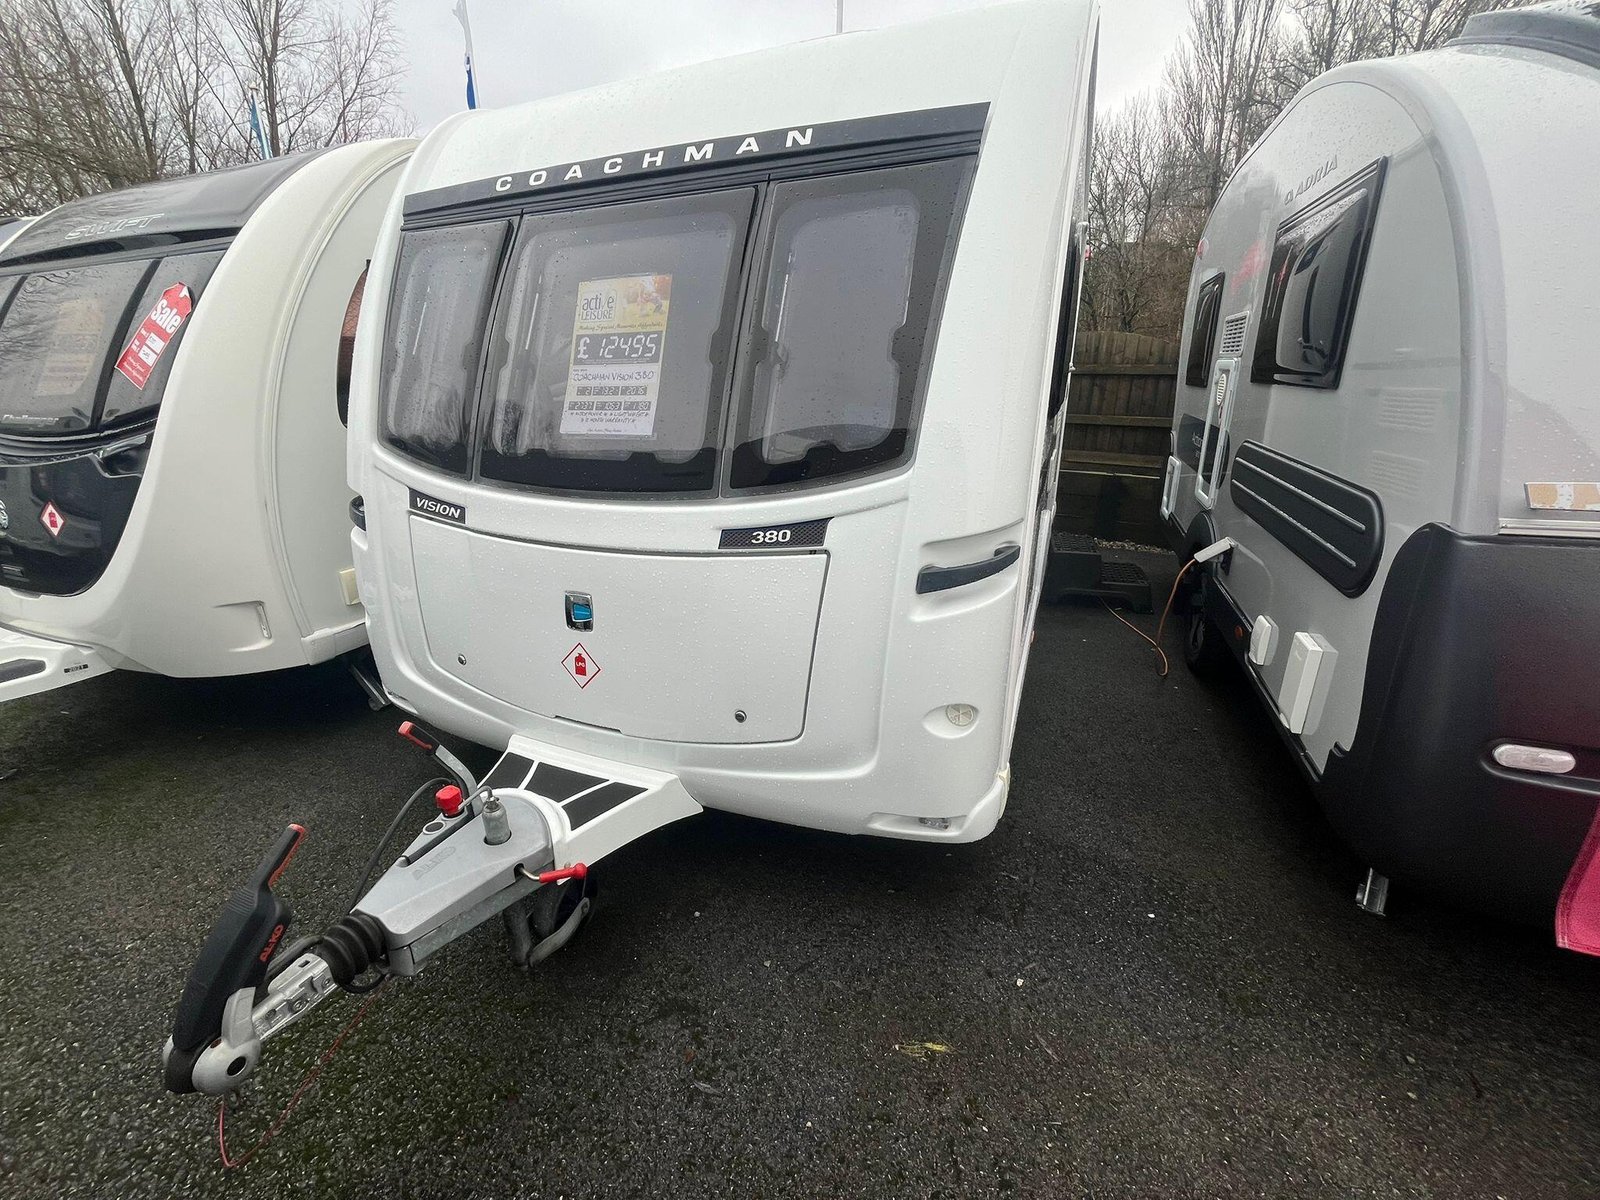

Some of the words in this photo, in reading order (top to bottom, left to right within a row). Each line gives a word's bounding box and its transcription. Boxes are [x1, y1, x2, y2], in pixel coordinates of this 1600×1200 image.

[495, 127, 814, 192] COACHMAN
[65, 213, 165, 240] SWIFT
[150, 299, 182, 334] Sale
[581, 309, 613, 321] LEISURE
[577, 337, 590, 359] £
[599, 334, 658, 359] 12495
[635, 370, 655, 381] 380
[416, 496, 461, 519] VISION
[751, 529, 791, 544] 380
